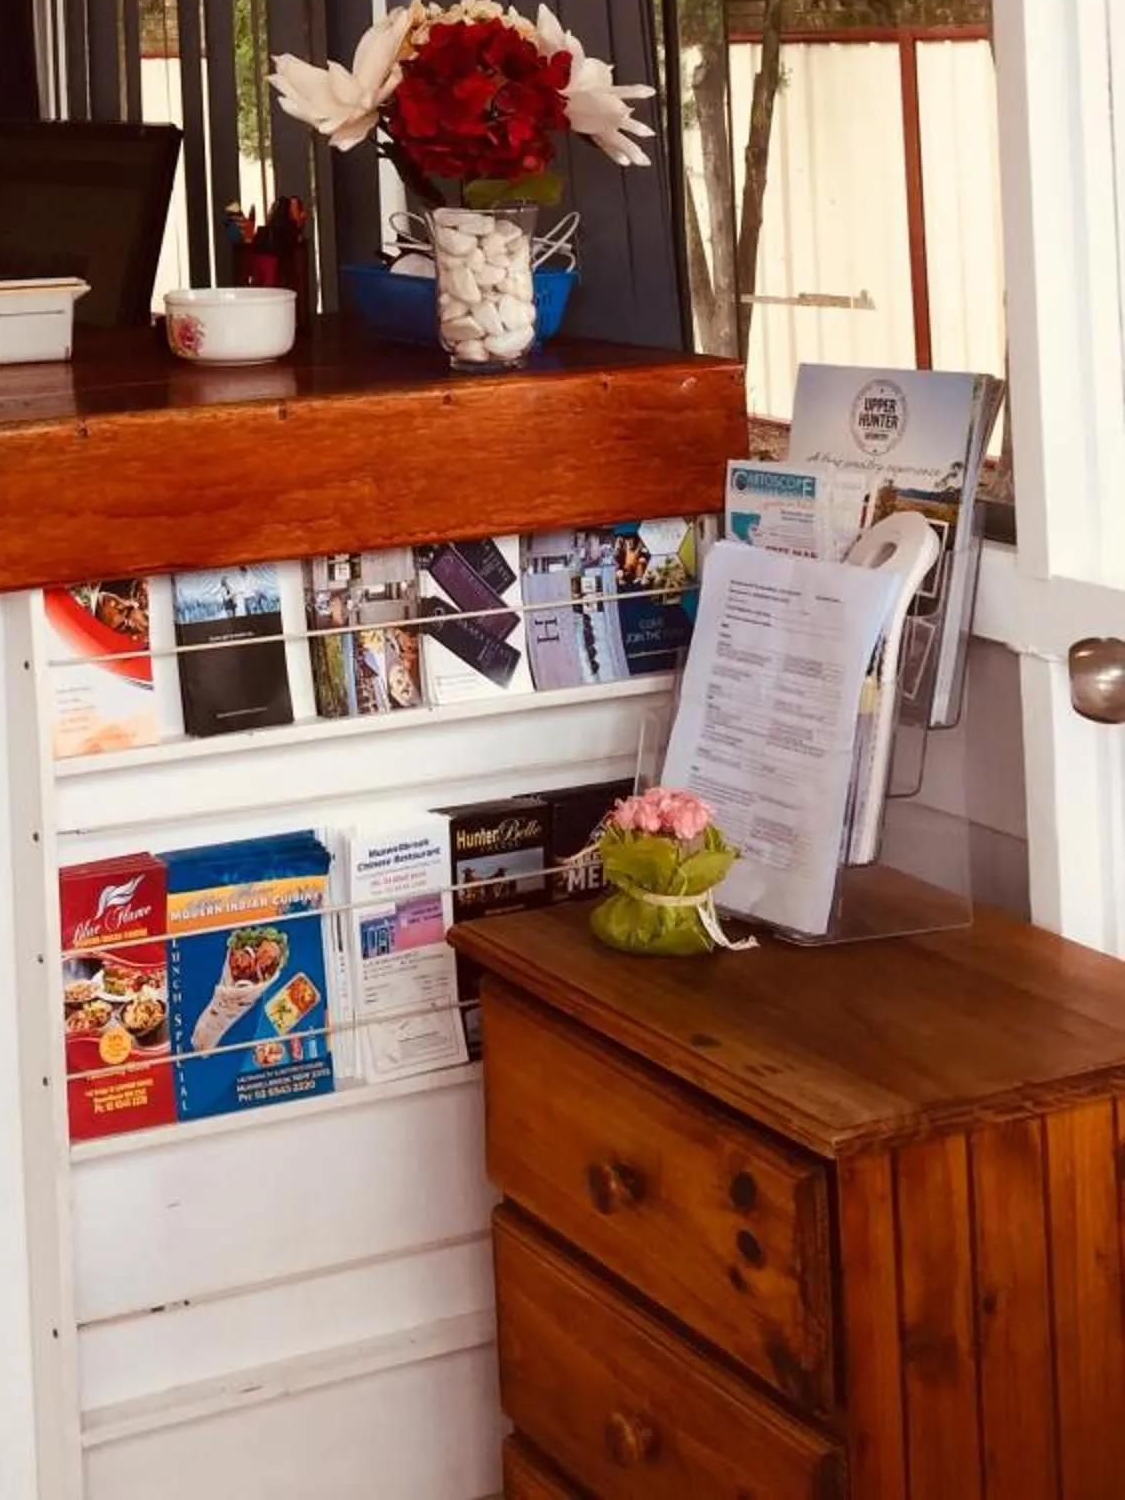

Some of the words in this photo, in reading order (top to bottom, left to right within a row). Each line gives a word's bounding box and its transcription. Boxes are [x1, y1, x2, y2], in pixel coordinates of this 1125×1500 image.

[864, 398, 896, 412] UPPER
[858, 412, 899, 429] HUNTER
[456, 827, 497, 849] Hunter
[394, 846, 440, 863] Restaurant
[567, 866, 606, 892] ME
[226, 899, 268, 912] INDIAN
